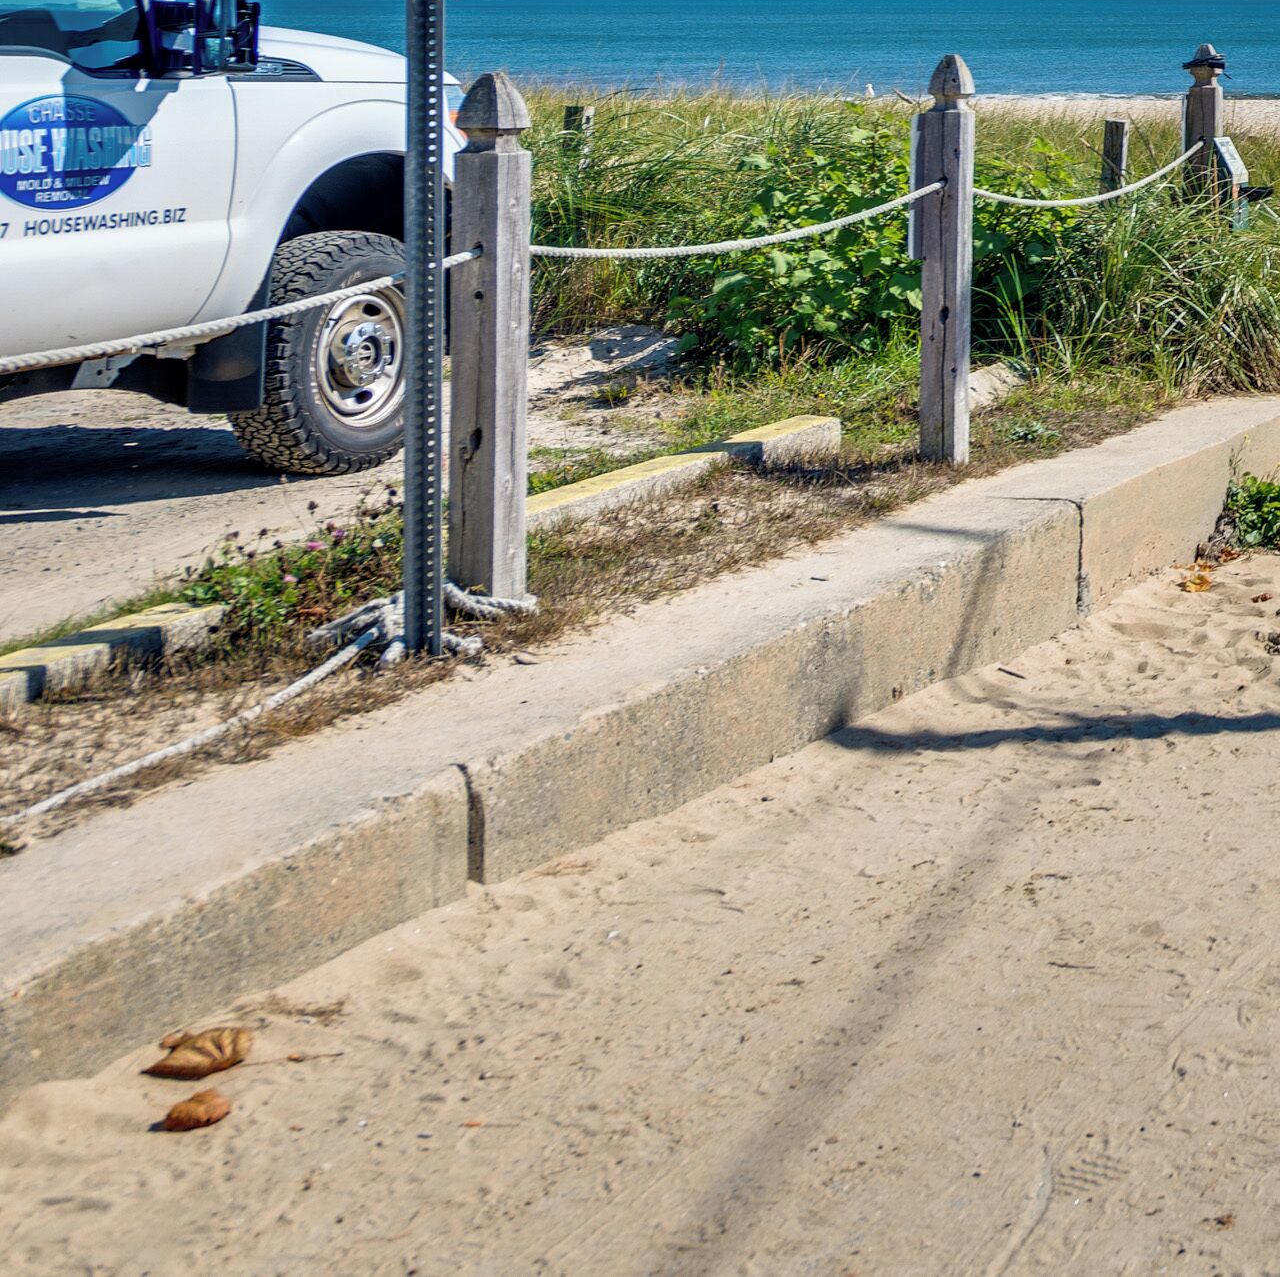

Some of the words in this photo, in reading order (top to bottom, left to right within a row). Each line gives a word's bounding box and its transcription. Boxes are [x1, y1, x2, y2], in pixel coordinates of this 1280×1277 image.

[28, 101, 96, 124] CHASSE
[50, 123, 152, 172] WASHING
[16, 178, 52, 191] MOLD
[53, 177, 64, 188] &
[65, 174, 112, 188] MILDEW
[35, 188, 91, 203] REMOVAL
[24, 207, 188, 237] HOUSEWASHING.BIZ
